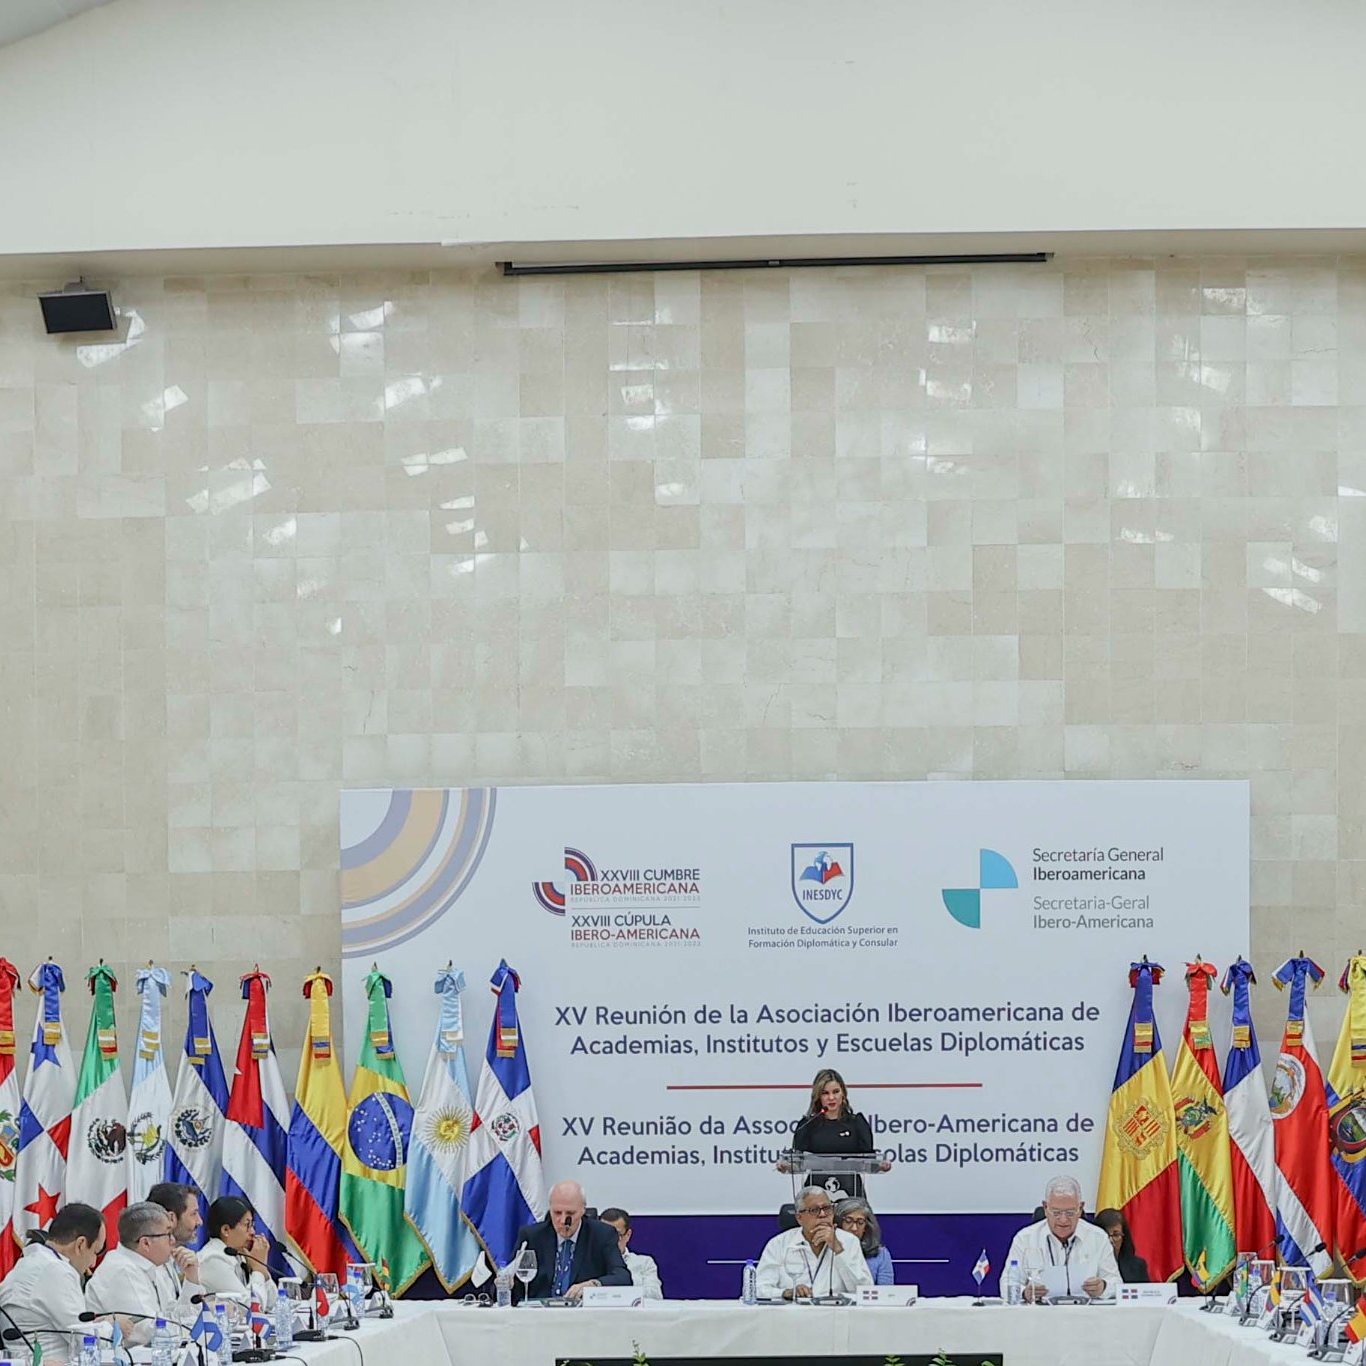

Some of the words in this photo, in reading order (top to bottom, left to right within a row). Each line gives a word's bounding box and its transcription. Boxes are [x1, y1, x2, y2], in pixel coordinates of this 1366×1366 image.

[1032, 847, 1105, 862] Secretaría
[1108, 847, 1164, 862] General
[600, 870, 640, 881] XXVIII
[643, 869, 700, 881] CUMBRE
[1033, 867, 1146, 881] Iberoamericana
[570, 883, 700, 895] IBEROAMERICANA
[802, 889, 843, 900] INESDYC
[1033, 895, 1150, 910] Secretaria-Geral
[571, 915, 611, 928] XXVIII
[614, 912, 672, 927] CÚPULA
[1033, 915, 1154, 929] Ibero-Americana
[570, 928, 701, 941] IBERO-AMERICANA
[748, 927, 785, 935] Instituto
[787, 926, 799, 935] de
[801, 925, 846, 935] Educación
[848, 926, 886, 936] Superior
[748, 938, 796, 948] Formación
[797, 938, 850, 949] Diplomática
[852, 940, 857, 948] y
[859, 938, 898, 947] Consular
[555, 1007, 588, 1025] XV
[595, 1005, 686, 1025] Reunión
[693, 1004, 723, 1024] de
[730, 1004, 748, 1024] la
[756, 1003, 880, 1023] Asociación
[888, 1002, 1064, 1023] Iberoamericana
[1071, 1001, 1100, 1022] de
[570, 1034, 699, 1056] Academias,
[706, 1034, 809, 1054] Institutos
[817, 1038, 829, 1058] y
[836, 1032, 933, 1053] Escuelas
[940, 1031, 1085, 1057] Diplomáticas
[562, 1117, 595, 1136] XV
[602, 1116, 692, 1136] Reunião
[699, 1115, 725, 1135] da
[732, 1115, 797, 1135] Assoc
[869, 1112, 1057, 1134] Ibero-Americana
[1065, 1113, 1095, 1133] de
[577, 1145, 706, 1167] Academias,
[935, 1142, 1079, 1169] Diplomáticas
